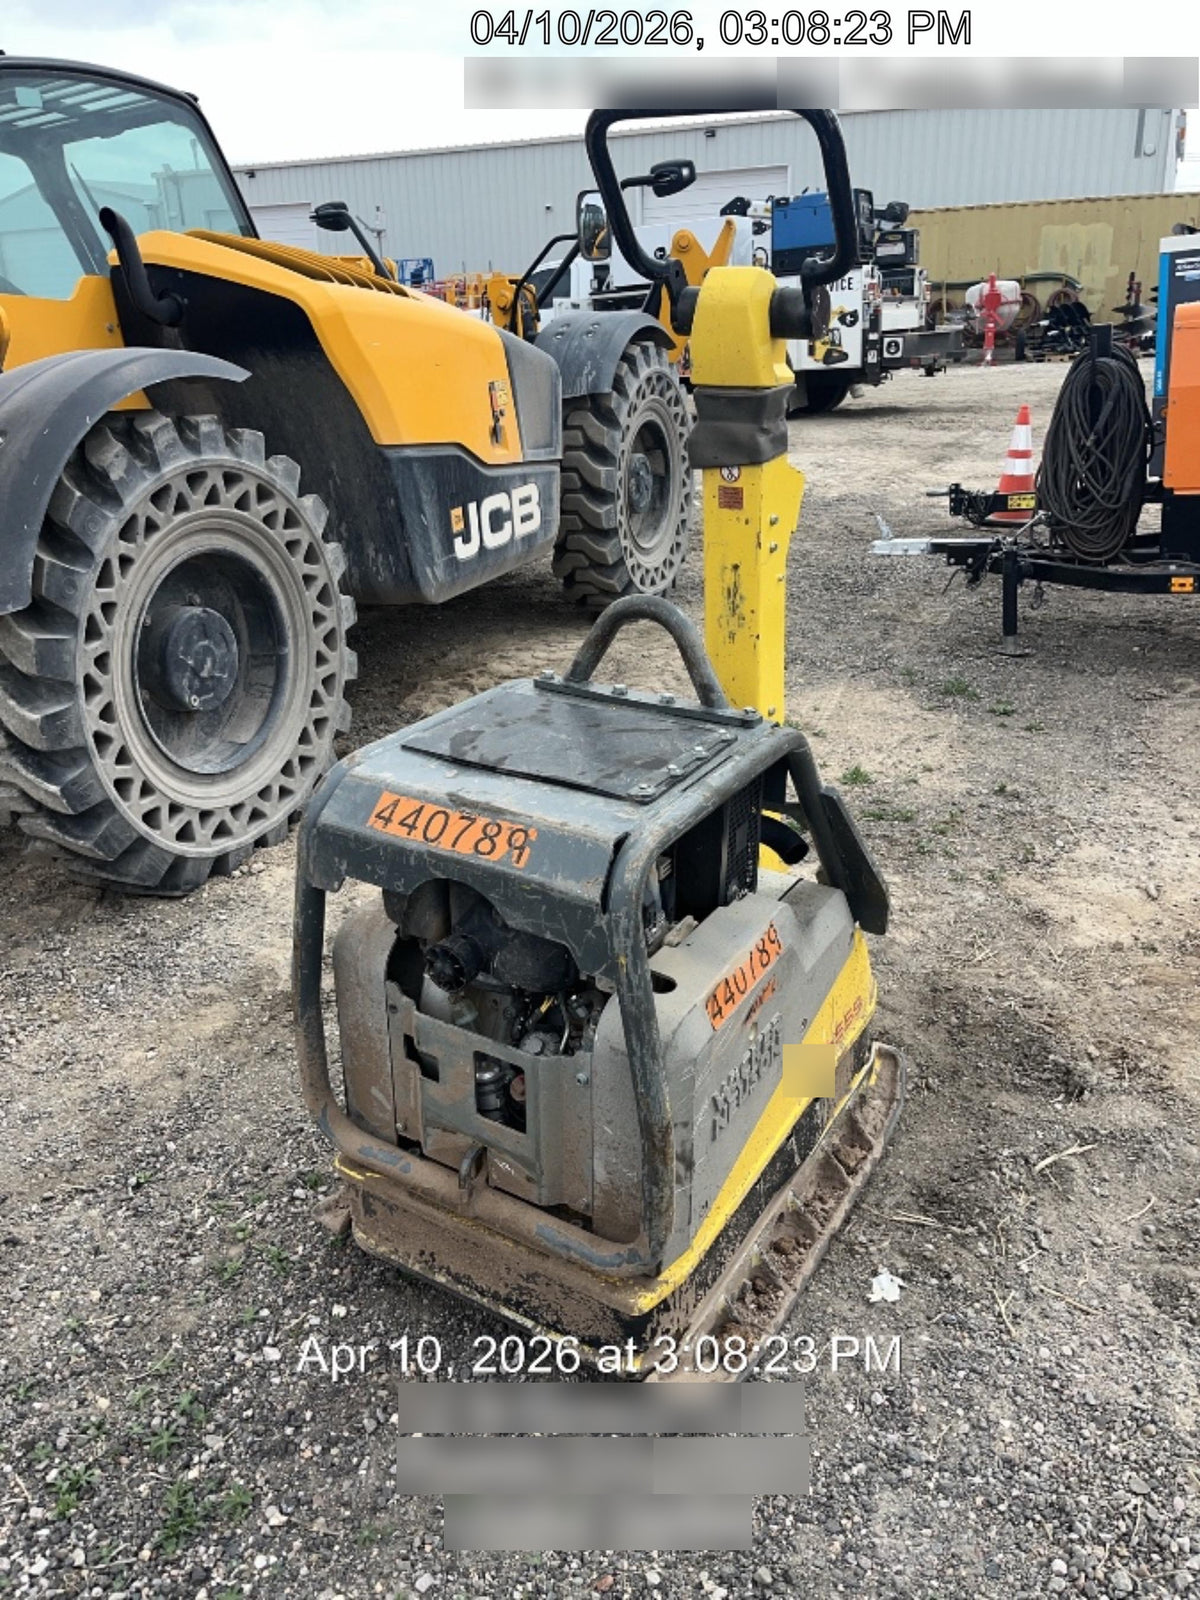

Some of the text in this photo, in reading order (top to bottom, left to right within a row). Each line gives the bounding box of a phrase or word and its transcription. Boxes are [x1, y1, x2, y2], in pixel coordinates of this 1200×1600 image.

[828, 277, 854, 291] VICE
[453, 483, 541, 561] JCB
[374, 798, 530, 865] 440789
